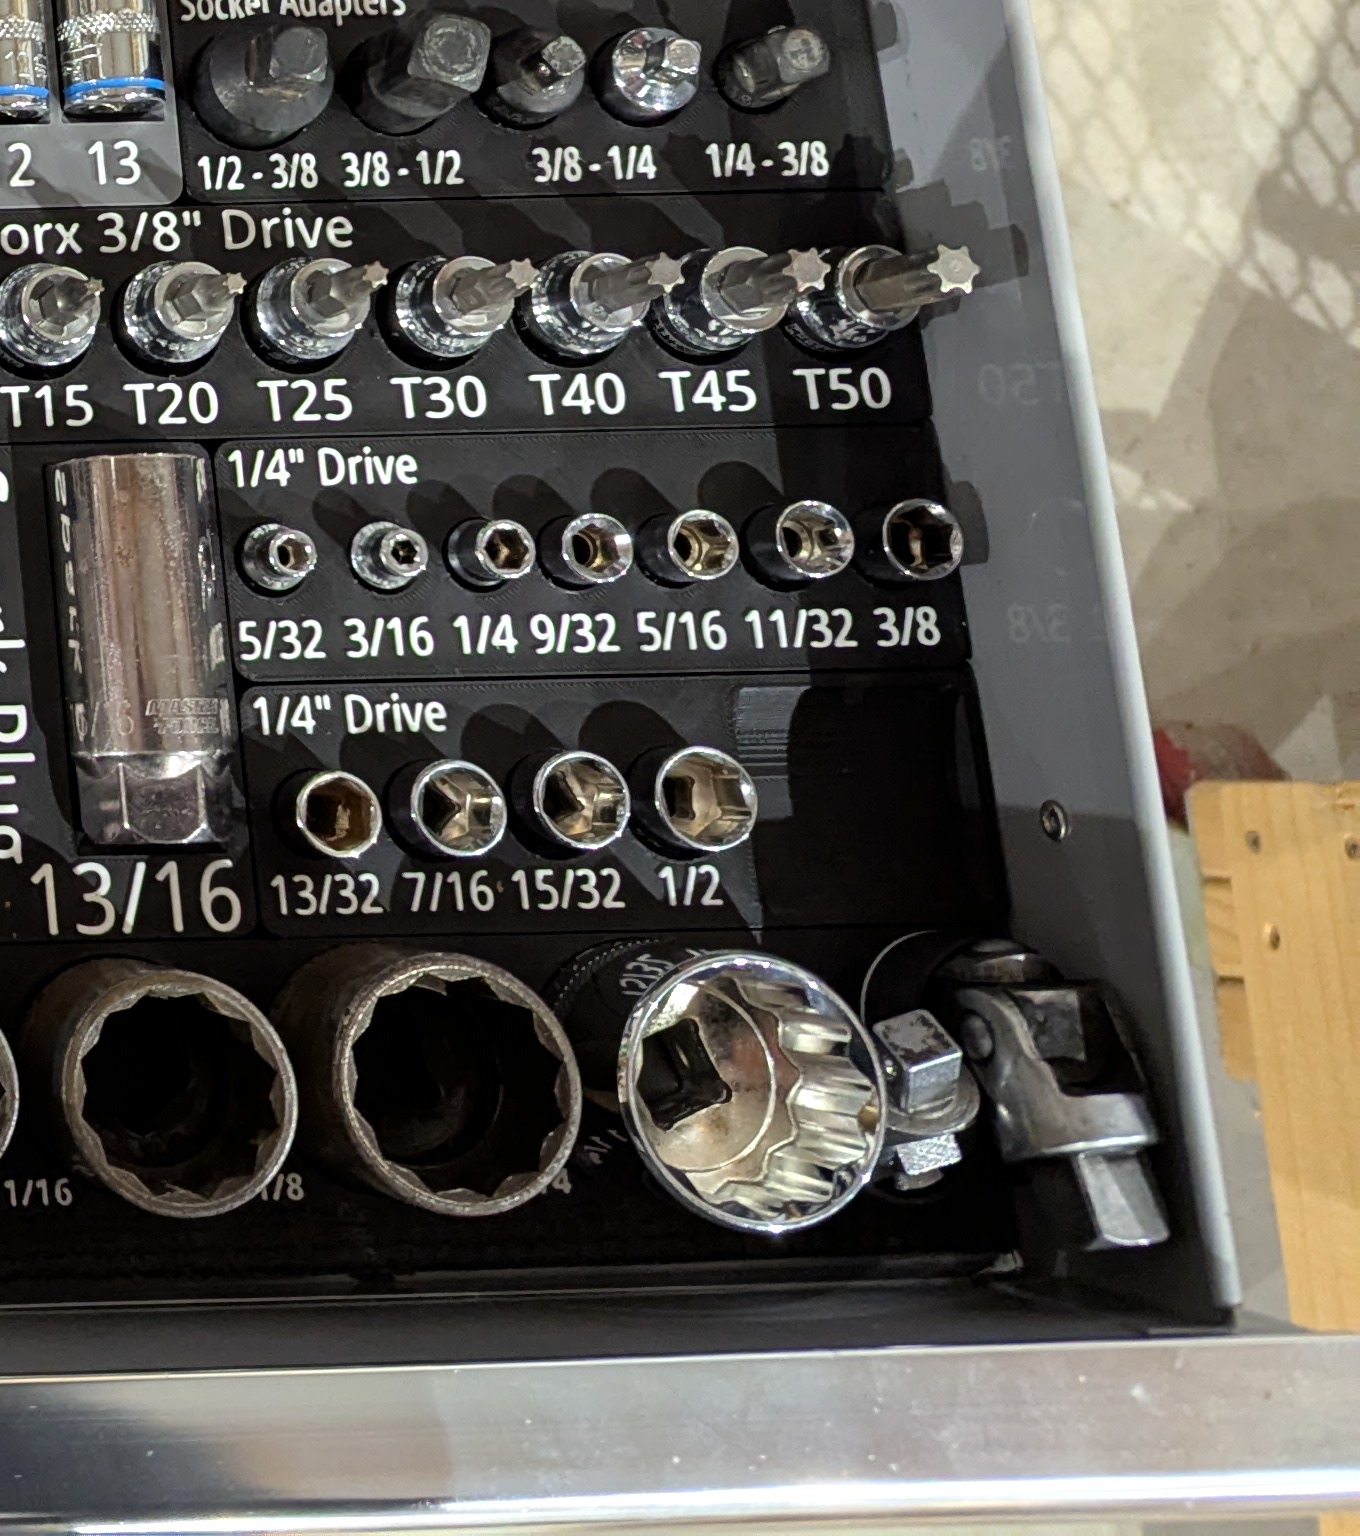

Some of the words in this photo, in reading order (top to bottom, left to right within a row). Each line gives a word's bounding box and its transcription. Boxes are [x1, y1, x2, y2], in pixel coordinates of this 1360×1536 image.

[88, 141, 140, 185] 13
[97, 211, 202, 252] 3/8"
[222, 207, 353, 249] Drive
[0, 385, 93, 427] T15
[123, 382, 218, 424] T20
[257, 379, 352, 421] T25
[390, 375, 486, 418] T30
[528, 373, 625, 415] T40
[658, 370, 756, 412] T45
[793, 367, 891, 410] T50
[228, 448, 304, 487] 1/4"
[318, 446, 417, 486] Drive
[239, 620, 326, 660] 5/32
[344, 616, 434, 658] 3/16
[453, 614, 518, 654] 1/4
[530, 613, 620, 654] 9/32
[637, 610, 727, 651] 5/16
[745, 608, 858, 649] 11/32
[873, 606, 941, 647] 3/8
[253, 694, 331, 735] 1/4"
[344, 693, 447, 734] Drive
[31, 859, 241, 935] 13/16
[271, 873, 383, 915] 13/32
[402, 870, 494, 911] 7/16
[512, 868, 625, 910] 15/32
[659, 865, 723, 906] 1/2
[4, 1178, 72, 1207] 1/16
